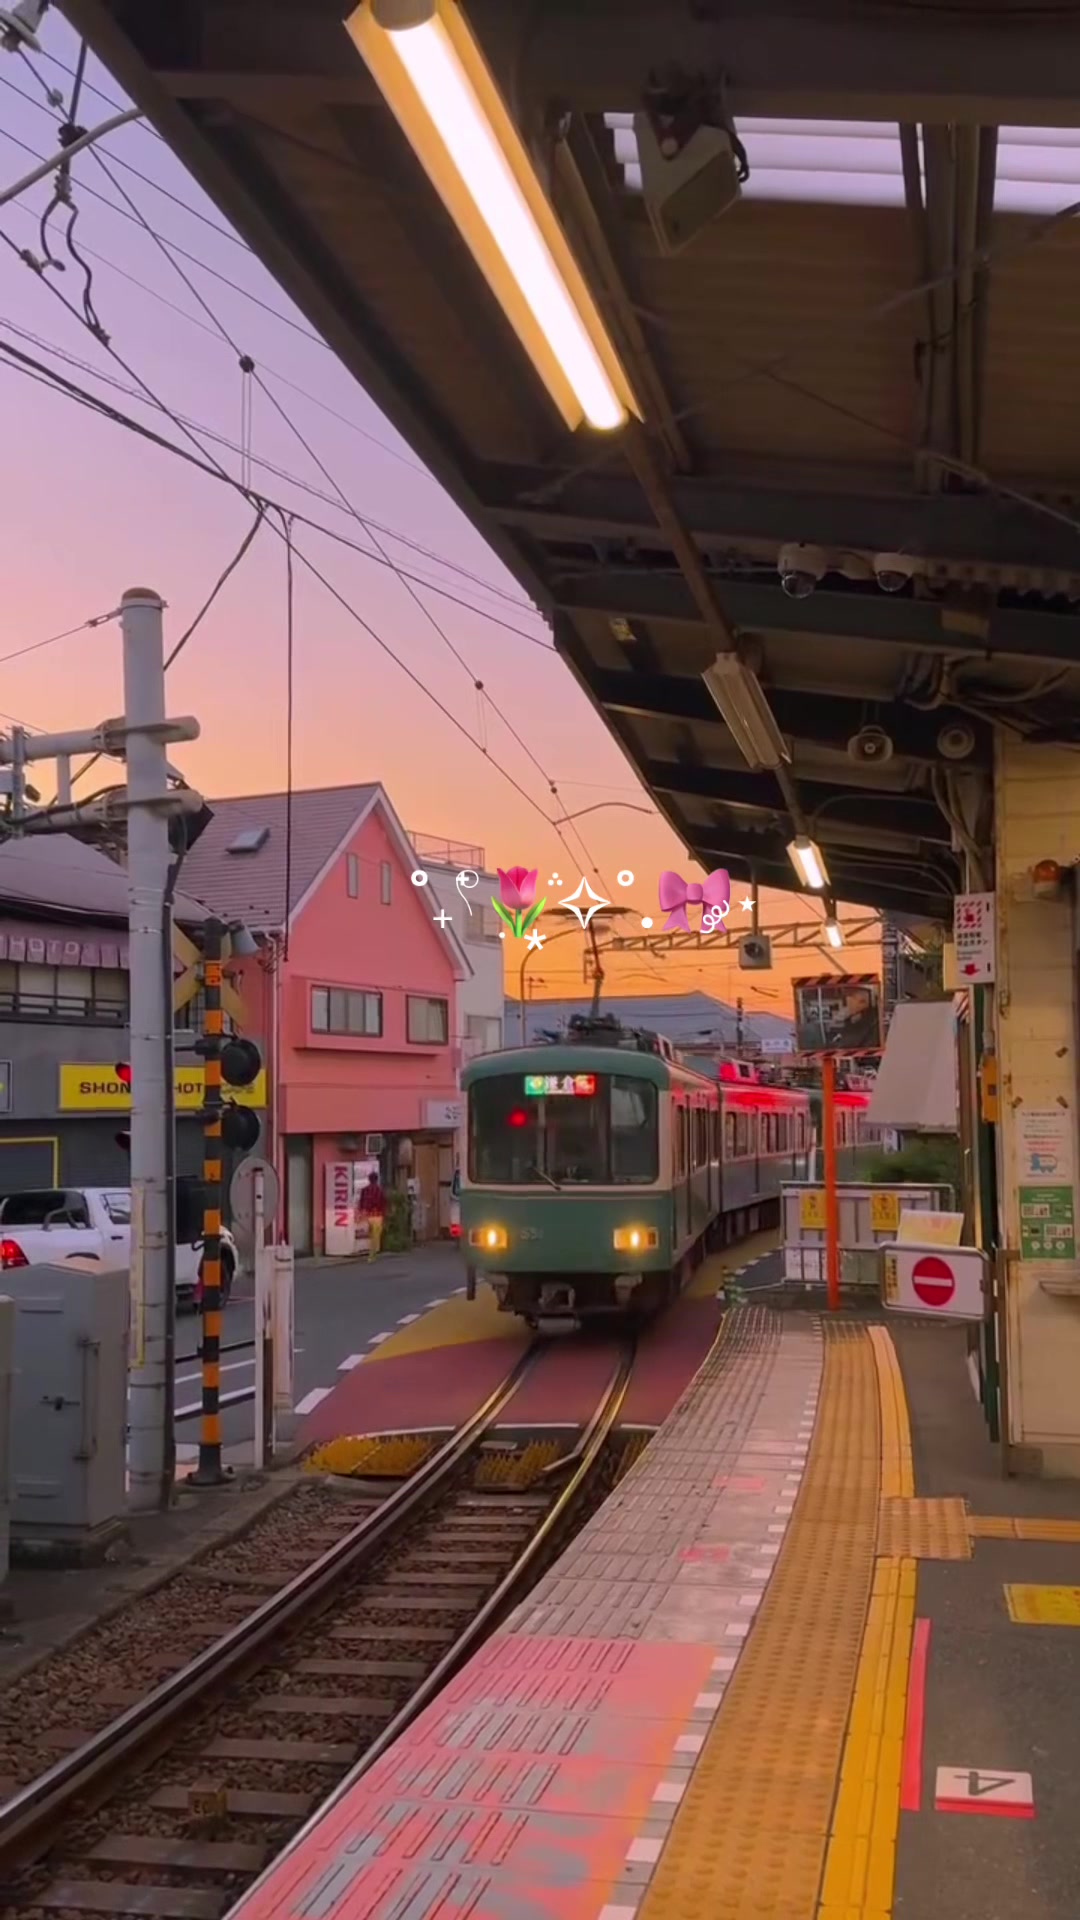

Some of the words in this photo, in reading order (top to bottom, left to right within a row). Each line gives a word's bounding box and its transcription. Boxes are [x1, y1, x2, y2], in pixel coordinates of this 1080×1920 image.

[79, 1082, 131, 1094] SHON
[173, 1083, 203, 1093] HOT
[334, 1166, 349, 1227] KIRIN
[953, 1770, 1016, 1796] 4
